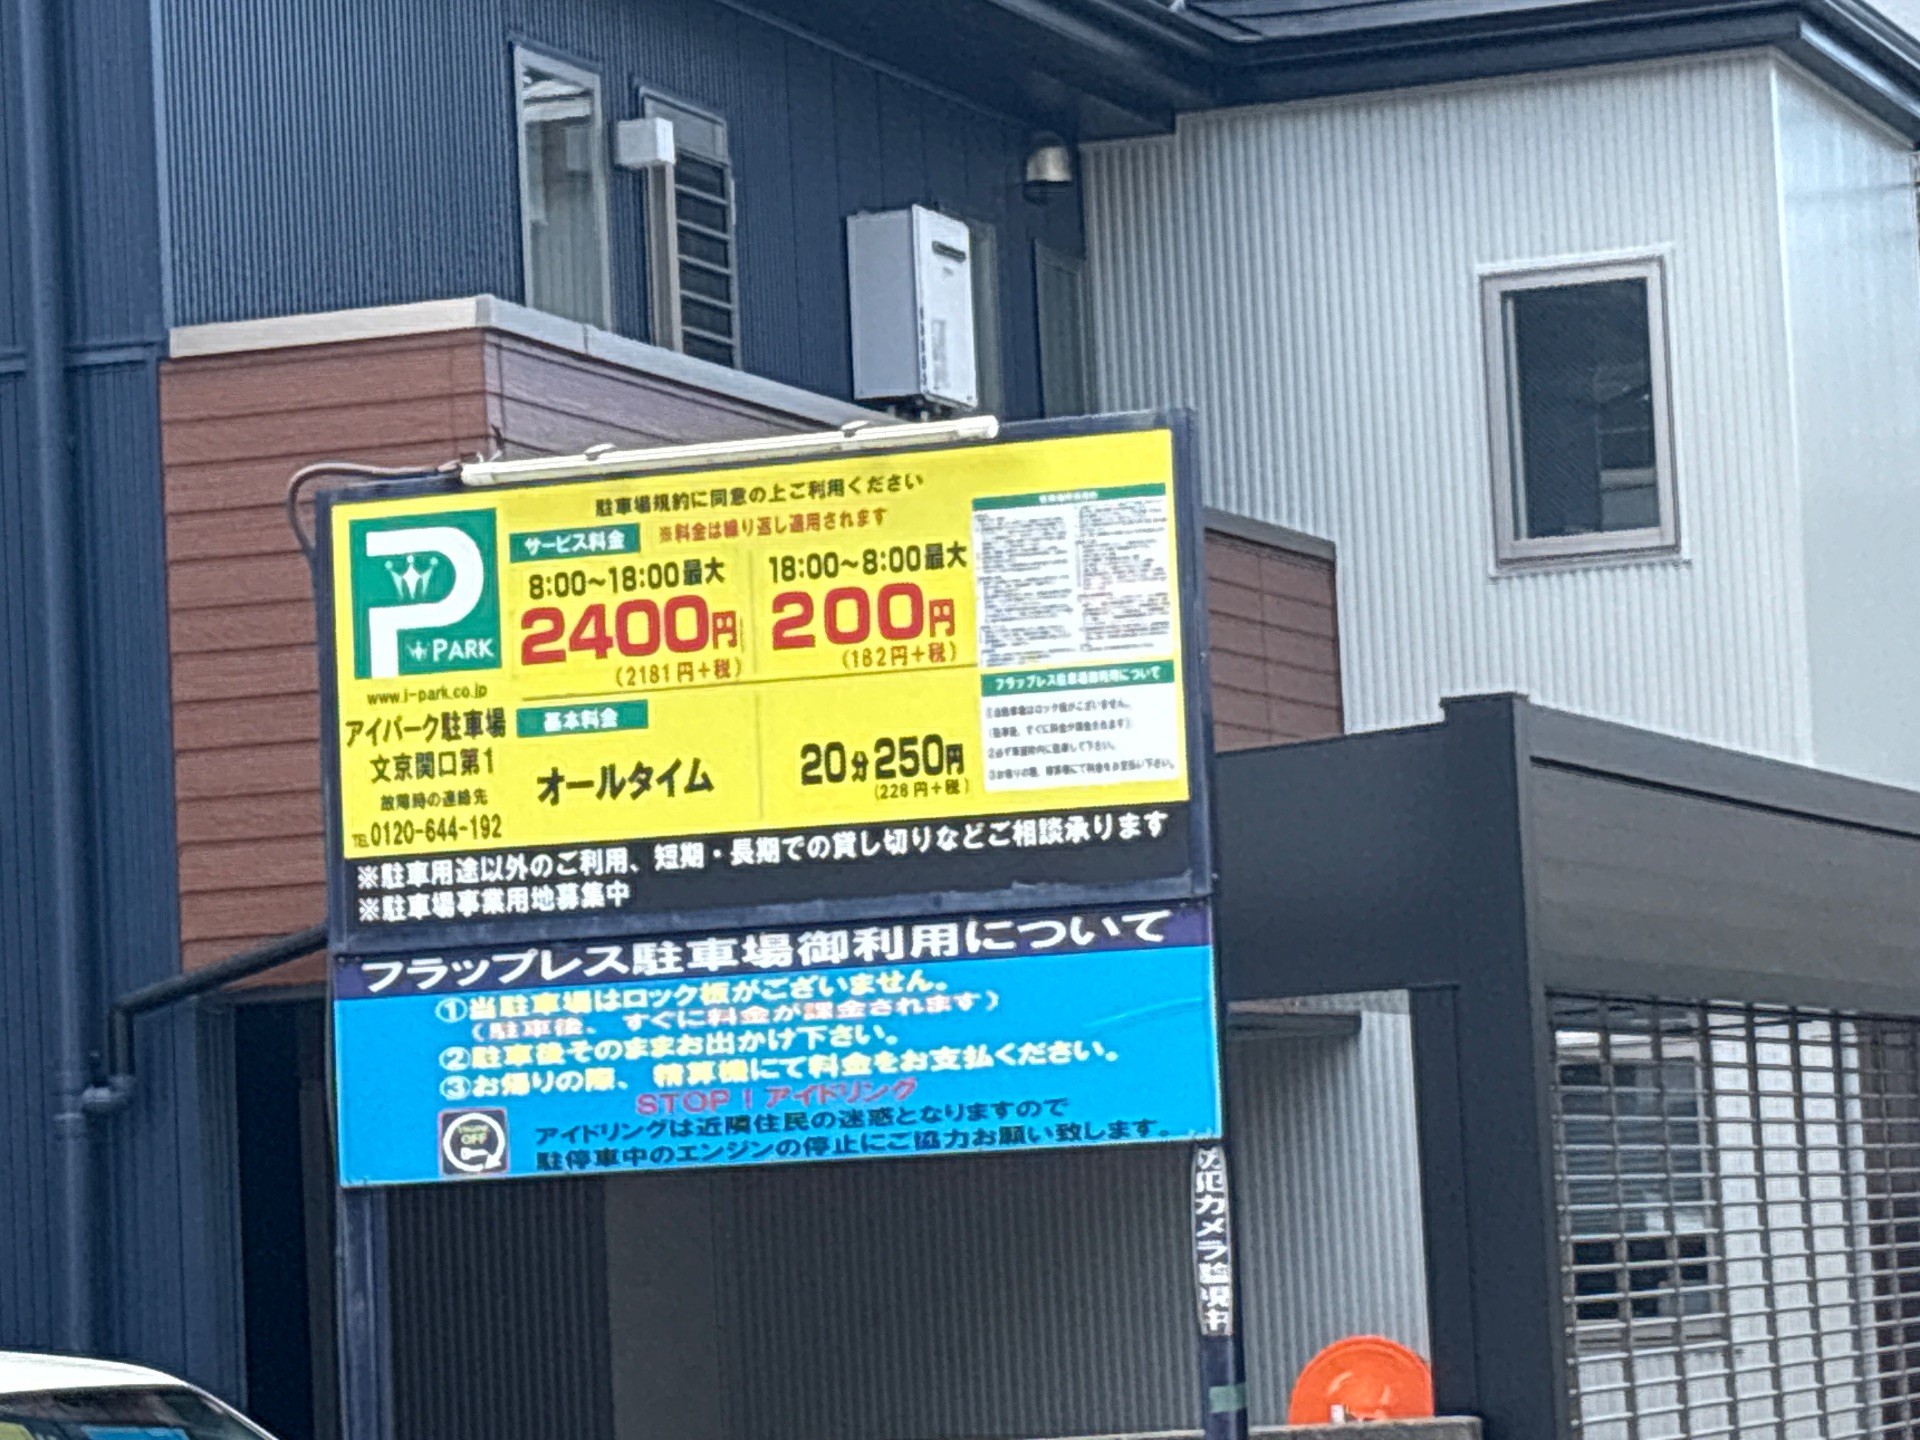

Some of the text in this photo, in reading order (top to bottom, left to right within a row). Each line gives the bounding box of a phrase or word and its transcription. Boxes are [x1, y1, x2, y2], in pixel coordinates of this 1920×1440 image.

[595, 474, 925, 517] 駐車場規約に同意の上ご利用ください
[524, 529, 626, 556] サービス料金
[658, 507, 888, 544] ※料金は繰り返し適用されます
[521, 594, 738, 666] 2400円
[772, 582, 956, 651] 200円
[433, 637, 495, 663] PARK
[345, 706, 507, 748] アイパーク駐車場
[543, 707, 619, 732] 基本料金
[370, 746, 494, 785] 文京関口第1
[801, 731, 965, 786] 20分250円
[380, 787, 488, 812] 故障時の連絡先
[536, 757, 715, 806] オールタイム
[370, 813, 503, 847] 0120-644-192
[358, 881, 632, 923] ※駐車場事業用地募集中
[362, 909, 1172, 993] フラップレス駐車場御利用について
[439, 1024, 898, 1072] ②駐車後そのままお出かけ下さい。
[535, 1096, 1071, 1146] アイドリングは近隣住民の迷惑となりますので
[536, 1119, 1170, 1172] 駐停車中のエンジンの停止にご協力お願い致します。
